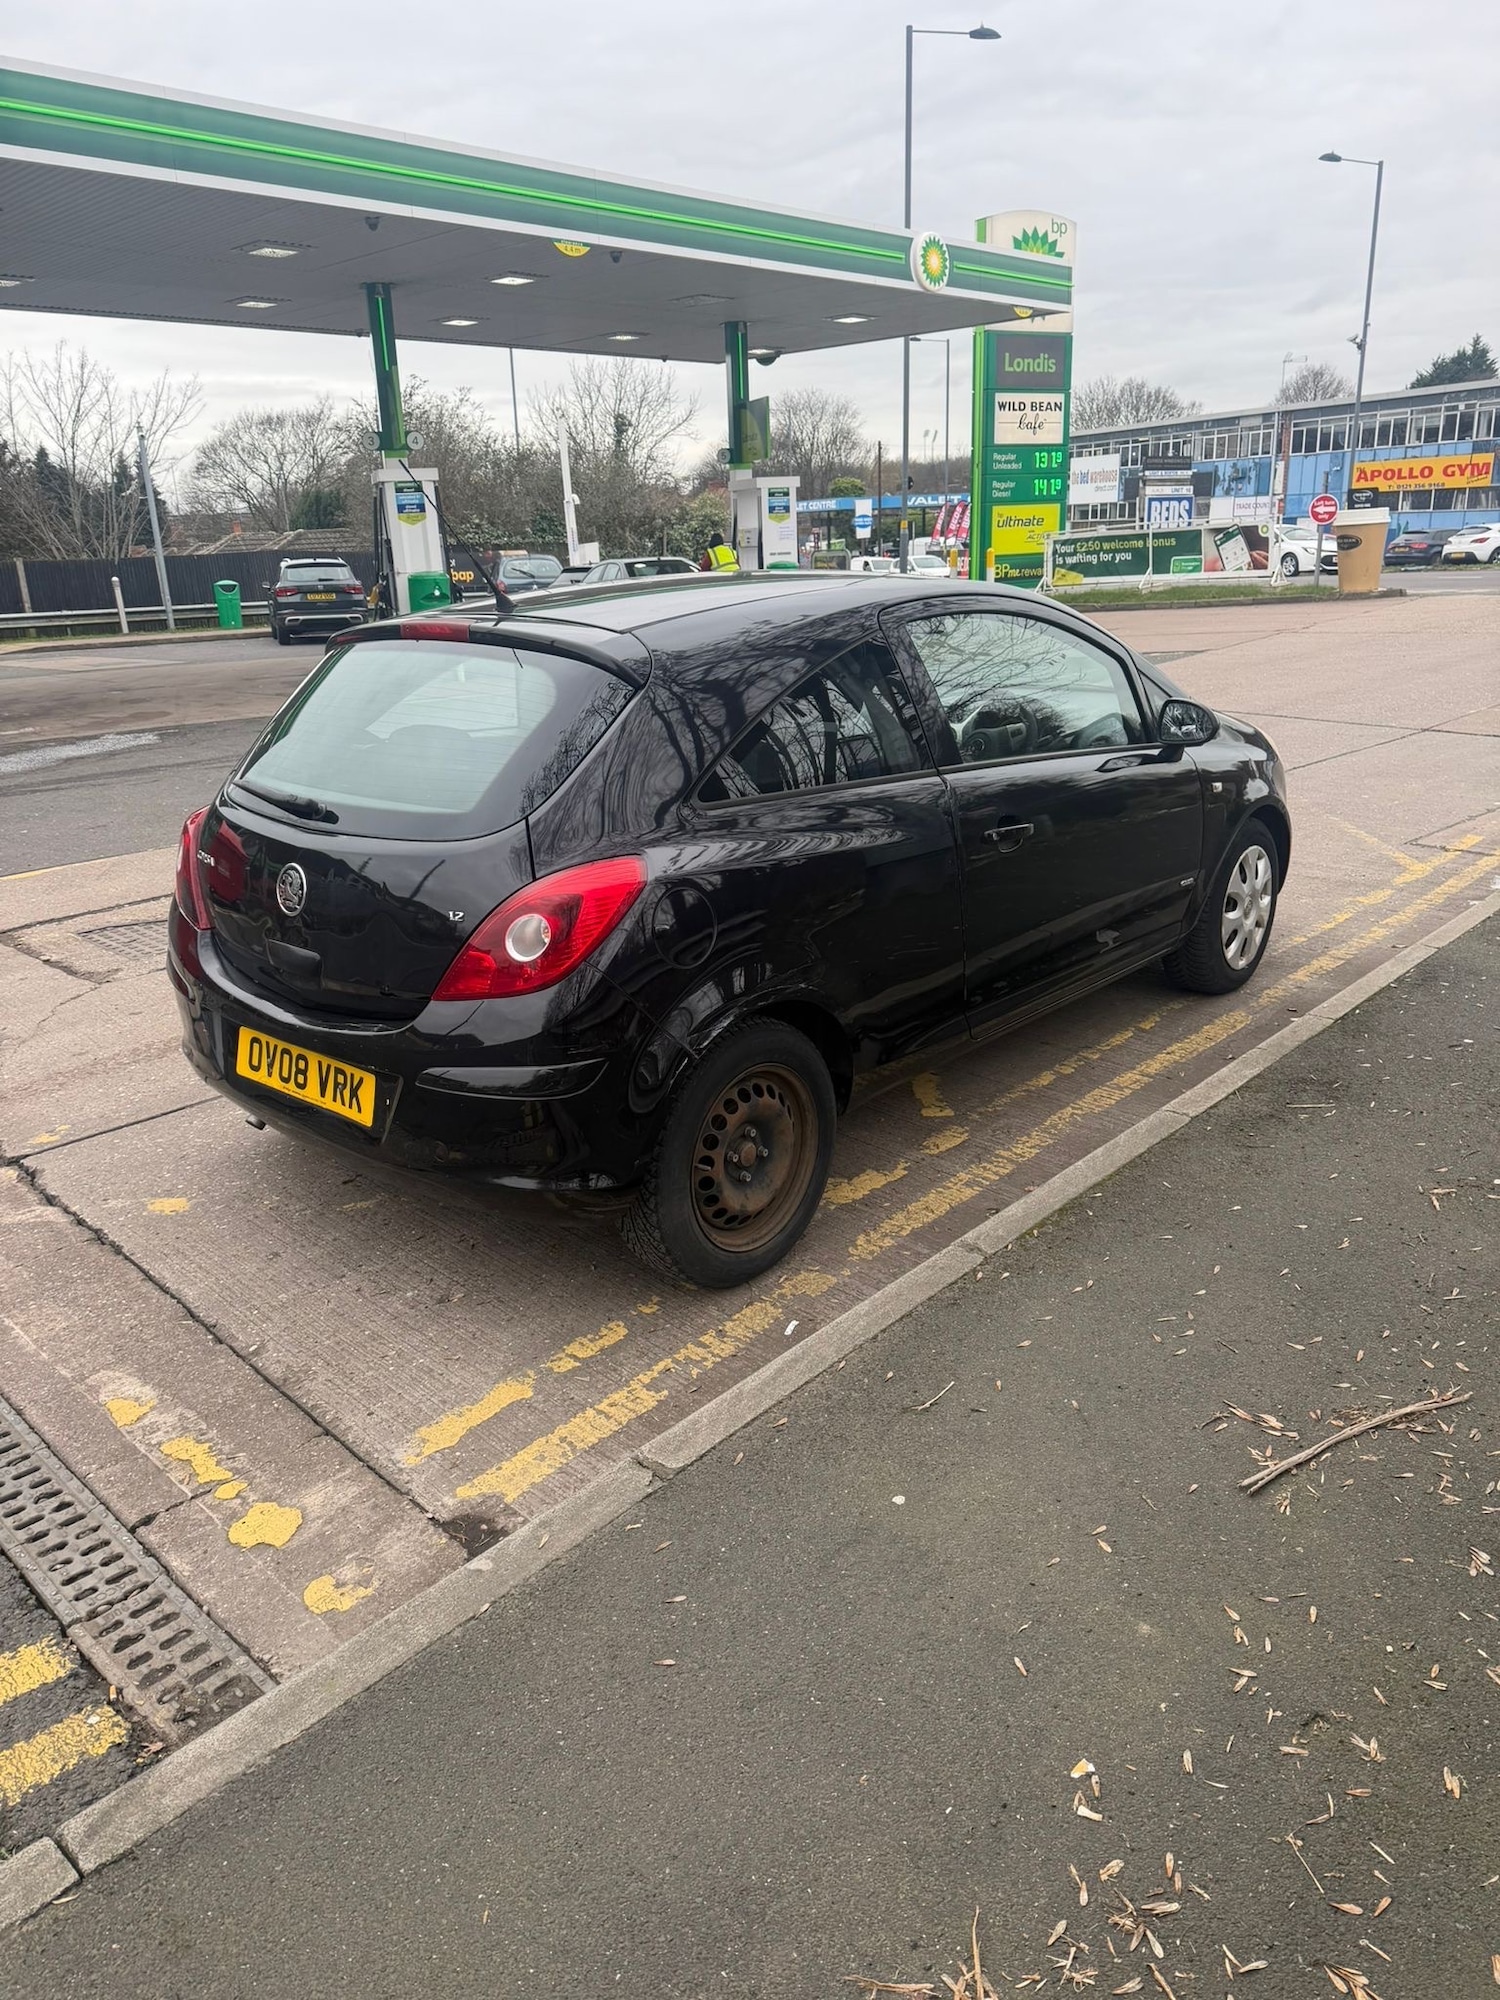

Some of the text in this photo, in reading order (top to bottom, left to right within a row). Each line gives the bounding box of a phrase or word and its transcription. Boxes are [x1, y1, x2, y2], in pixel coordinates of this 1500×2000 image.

[1051, 218, 1068, 237] bp
[1004, 352, 1056, 373] Londis
[997, 401, 1062, 412] WILD BEAN
[368, 436, 375, 446] 3
[412, 436, 419, 445] 4
[721, 451, 727, 459] 5
[993, 453, 1017, 461] Regular
[1355, 462, 1491, 483] APOLLO GYM
[992, 481, 1016, 490] Regular
[796, 501, 807, 510] LET
[808, 500, 837, 510] CENTRE
[1252, 501, 1277, 509] COUNTR
[1151, 500, 1190, 528] BEDS
[997, 515, 1045, 528] ultimate
[1055, 543, 1075, 554] Your
[1076, 541, 1101, 552] £250
[1102, 539, 1144, 550] welcome
[1055, 551, 1132, 565] is waiting for you
[1020, 568, 1044, 577] rewa
[248, 1036, 364, 1114] OV08 VRK
